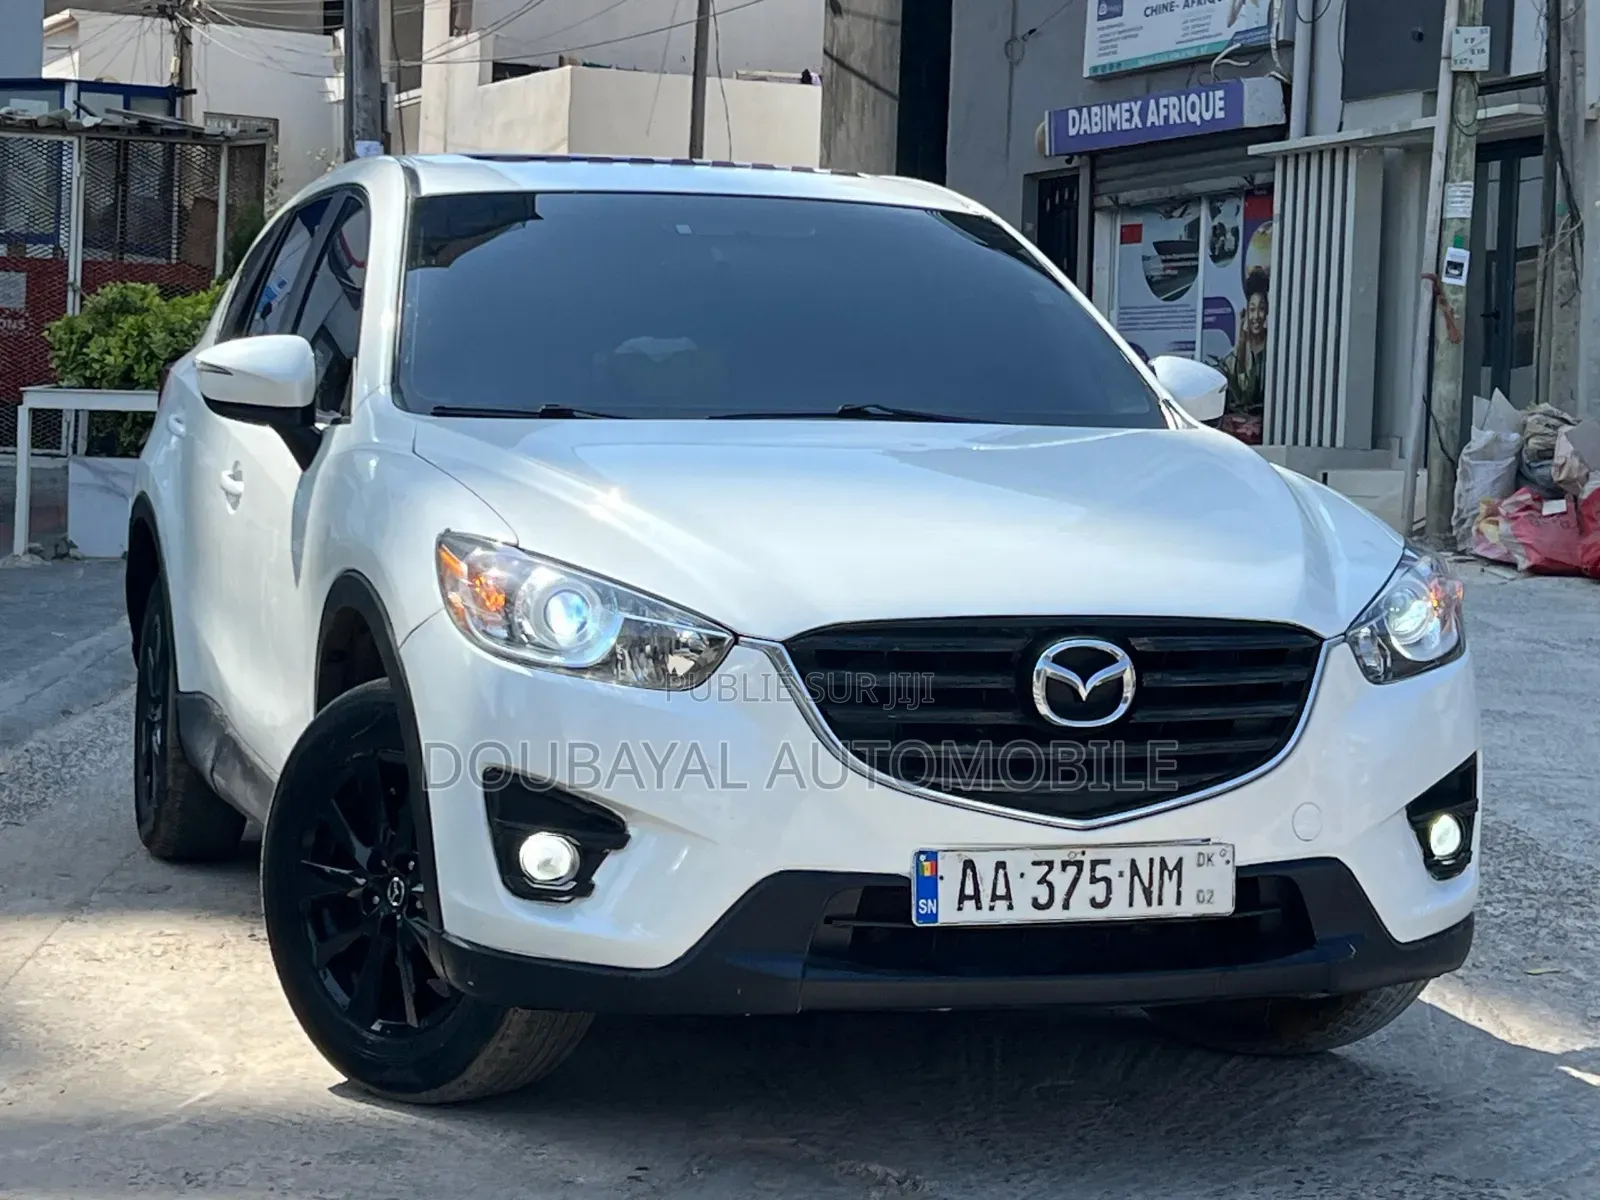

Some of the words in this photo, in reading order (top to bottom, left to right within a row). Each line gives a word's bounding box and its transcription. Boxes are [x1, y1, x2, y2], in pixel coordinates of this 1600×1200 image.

[1068, 100, 1142, 136] DABIMEX
[1147, 90, 1225, 125] AFRIQUE
[1196, 852, 1215, 867] DK
[1196, 888, 1215, 904] 02
[918, 899, 937, 914] SN
